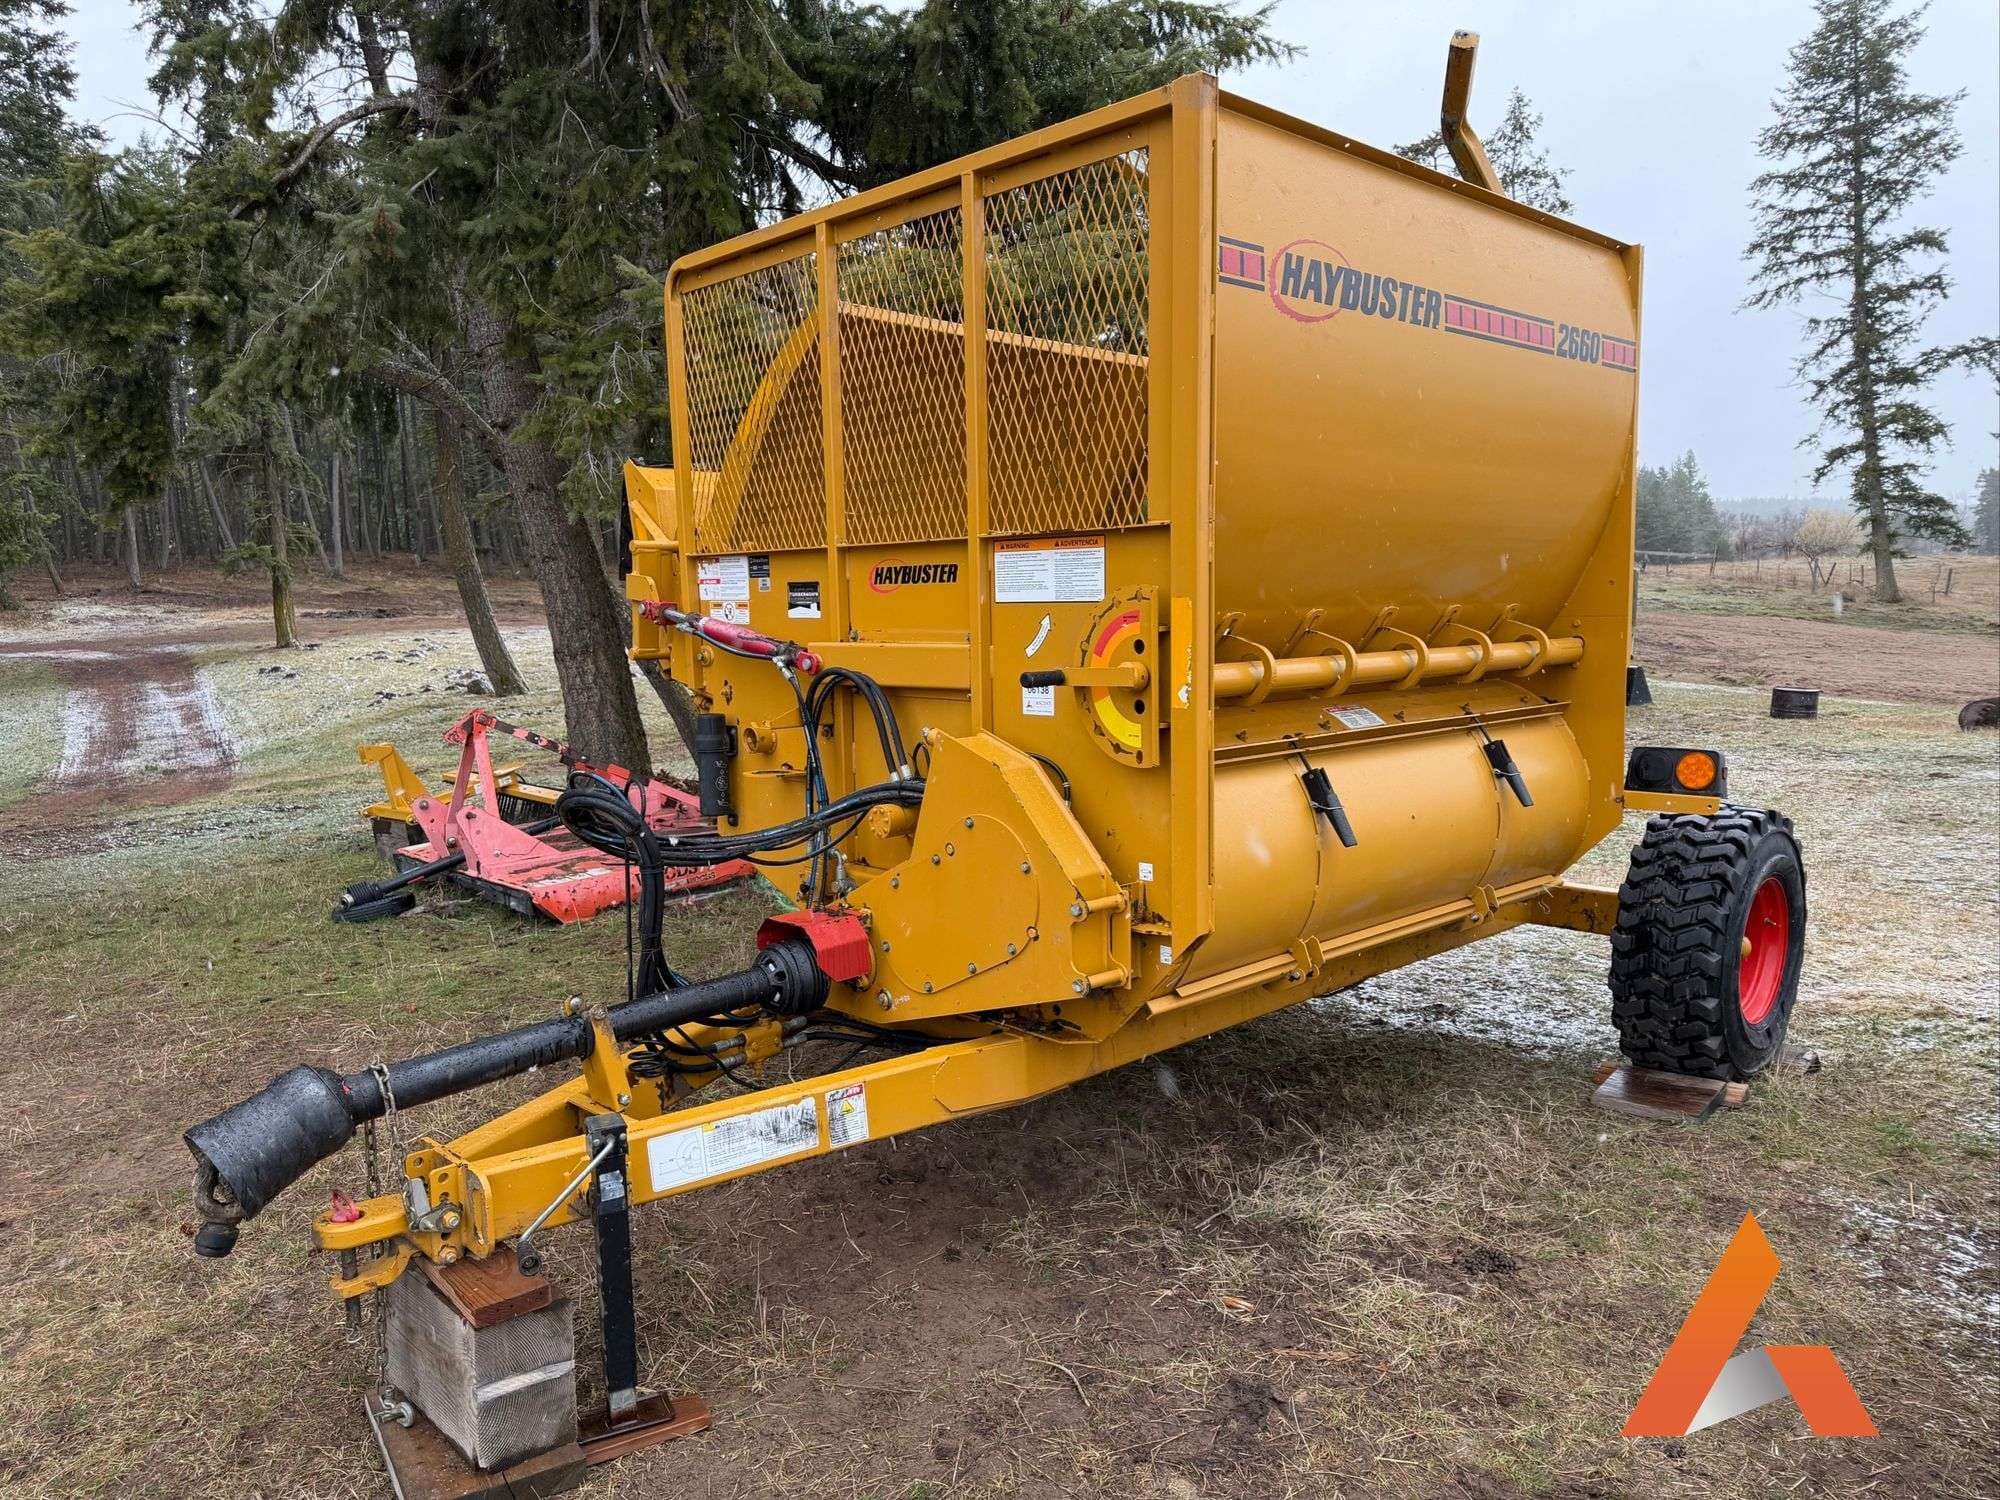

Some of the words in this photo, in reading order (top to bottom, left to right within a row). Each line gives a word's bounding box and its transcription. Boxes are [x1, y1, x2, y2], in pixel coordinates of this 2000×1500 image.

[1281, 252, 1442, 329] HAYBUSTER
[1556, 323, 1601, 364] 2660
[874, 563, 958, 585] HAYBUSTER
